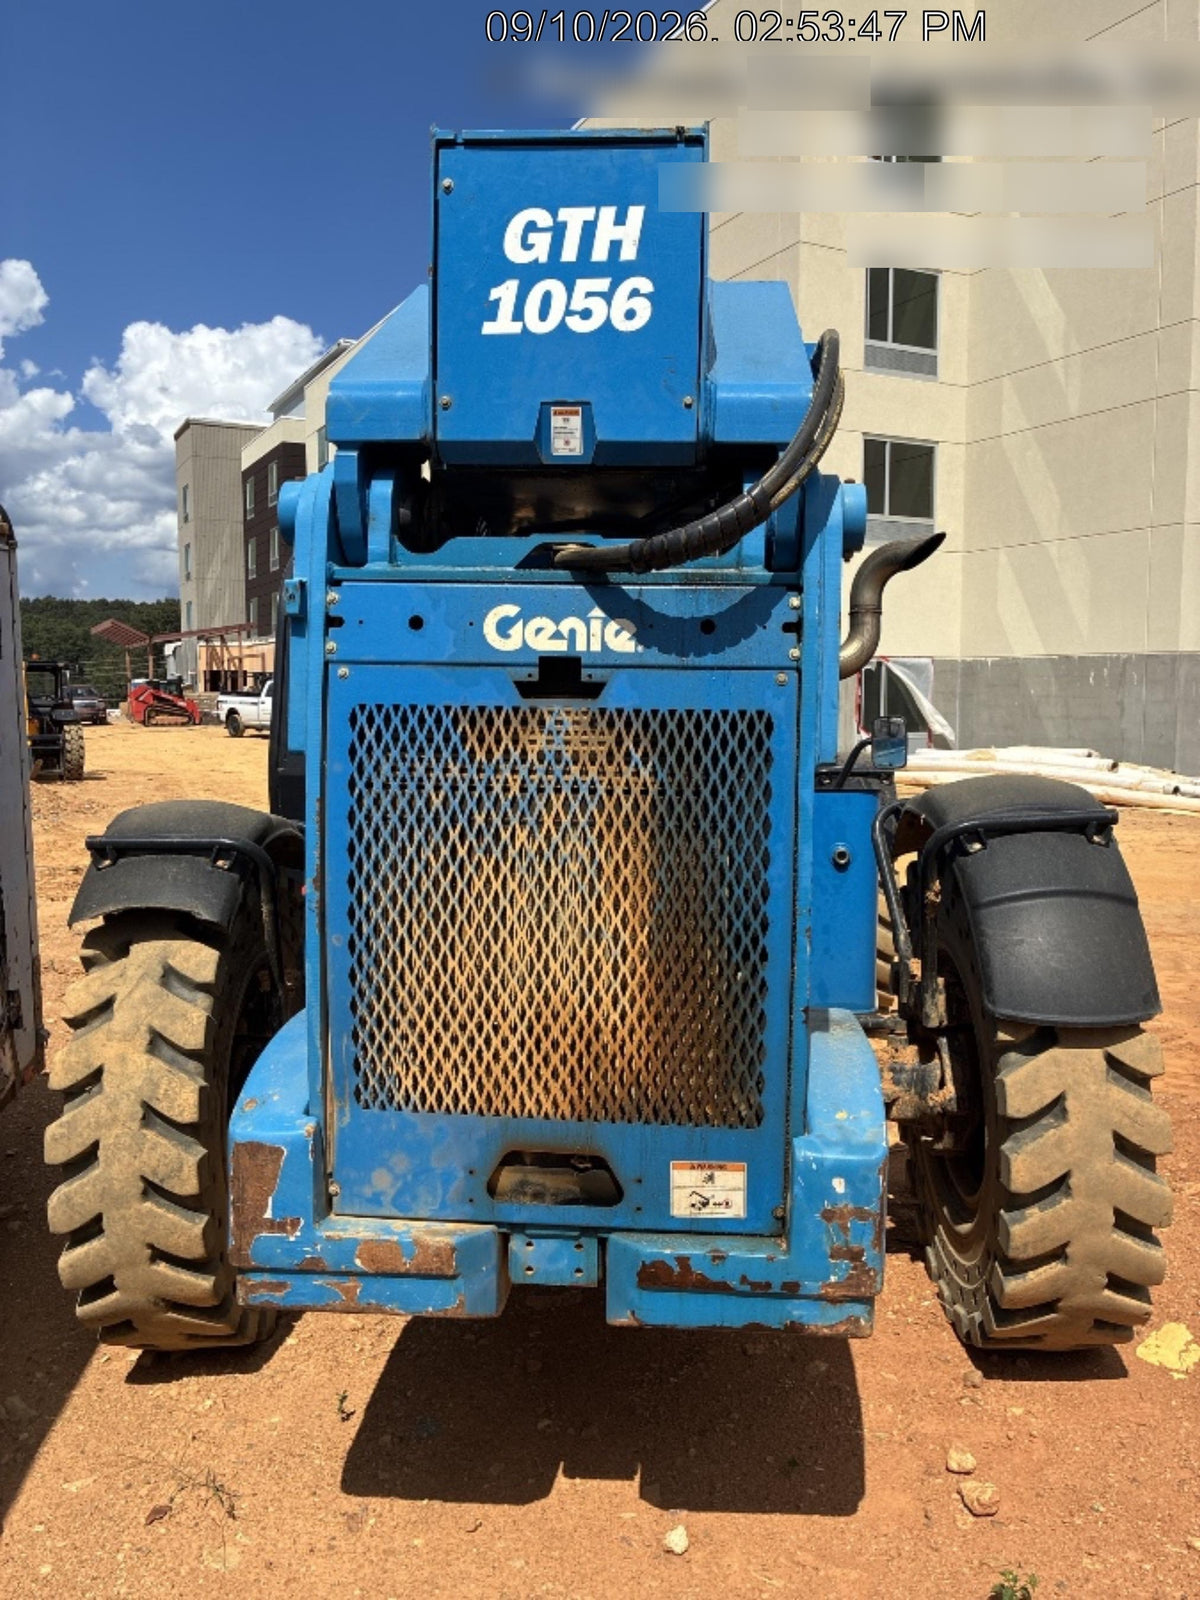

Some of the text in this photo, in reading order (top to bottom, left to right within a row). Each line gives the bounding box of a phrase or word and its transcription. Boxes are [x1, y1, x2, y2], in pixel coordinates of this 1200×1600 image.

[502, 205, 646, 264] GTH
[481, 276, 655, 335] 1056
[483, 603, 637, 653] Genie
